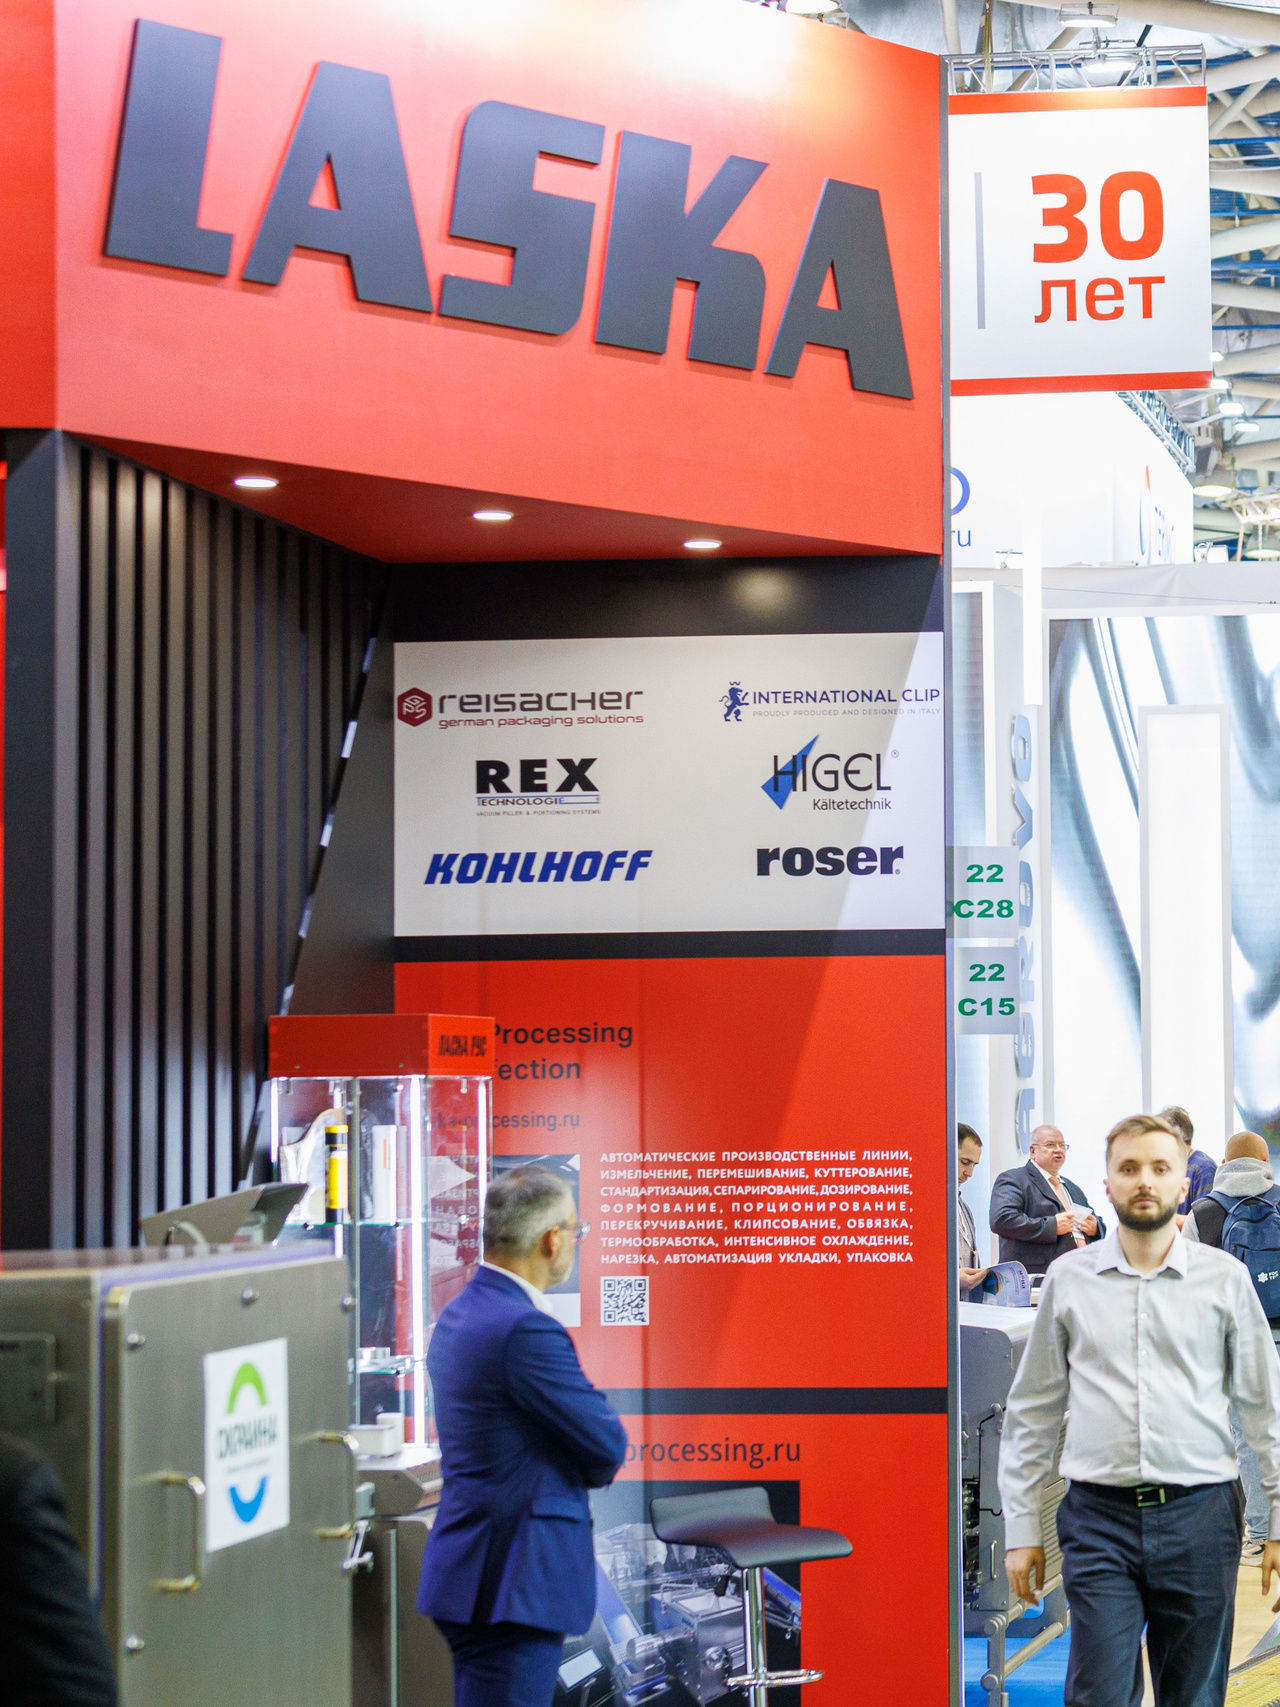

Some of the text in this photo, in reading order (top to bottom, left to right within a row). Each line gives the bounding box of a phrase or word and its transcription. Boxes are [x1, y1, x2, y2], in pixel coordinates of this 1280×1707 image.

[103, 18, 915, 400] LASKA
[1031, 170, 1164, 264] 30
[1034, 275, 1165, 323] лет
[752, 688, 941, 705] INTERNATIONAL CLIP
[438, 713, 645, 730] german packaging solutions
[793, 709, 839, 717] PRODUCED
[862, 708, 904, 716] DESIGNED
[475, 757, 600, 794] REX
[773, 752, 892, 793] HIGEL
[475, 794, 565, 807] TECHNOLOGIE
[812, 797, 893, 812] Kältetechnik
[423, 849, 654, 885] KOHLHOFF
[755, 845, 905, 877] roser
[966, 863, 1004, 883] 22
[953, 899, 1014, 919] C28
[969, 963, 1005, 982] 22
[957, 997, 1016, 1017] C15
[600, 1150, 913, 1163] АВТОМАТИЧЕСКИЕ ПРОИЗВОДСТВЕННЫЕ ЛИНИИ,
[600, 1167, 913, 1180] ИЗМЕЛЬЧЕНИЕ, ПЕРЕМЕШИВАНИЕ, КУТТЕРОВАНИЕ,
[600, 1184, 913, 1197] СТАНДАРТИЗАЦИЯ, СЕПАРИРОВАНИЕ, ДОЗИРОВАНИЕ,
[600, 1201, 914, 1214] ФОРМОВАНИЕ, ПОРЦИОНИРОВАНИЕ,
[600, 1218, 914, 1231] ПЕРЕКРУЧИВАНИЕ, КЛИПСОВАНИЕ, ОБВЯЗКА,
[600, 1235, 914, 1248] ТЕРМООБРАБОТКА, ИНТЕНСИВНОЕ ОХЛАЖДЕНИЕ,
[600, 1252, 914, 1265] НАРЕЗКА, АВТОМАТИЗАЦИЯ УКЛАДКИ, УПАКОВКА
[623, 1436, 801, 1469] processing.ru
